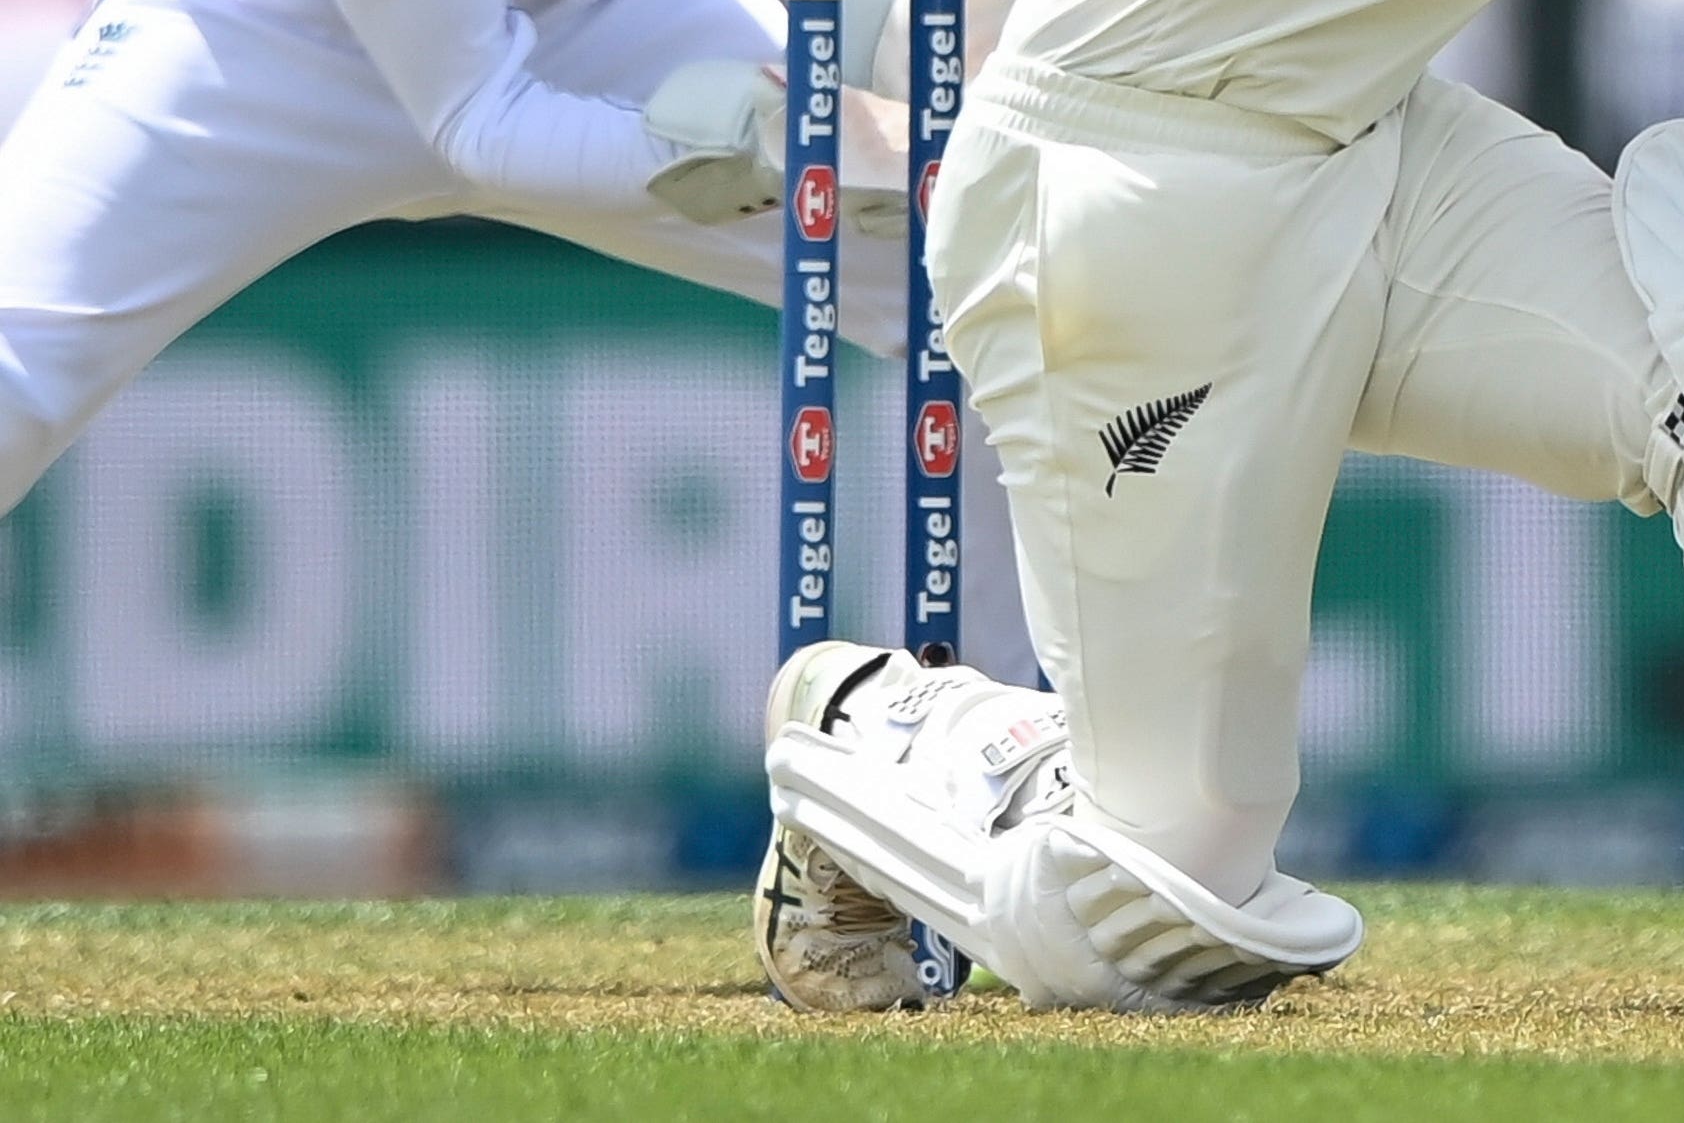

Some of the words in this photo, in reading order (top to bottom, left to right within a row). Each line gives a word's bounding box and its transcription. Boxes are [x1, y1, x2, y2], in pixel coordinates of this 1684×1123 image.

[799, 19, 841, 146] Tegel
[921, 13, 962, 141] Tegel
[794, 260, 836, 388] Tegel
[790, 501, 831, 628] Tegel
[917, 496, 958, 624] Tegel
